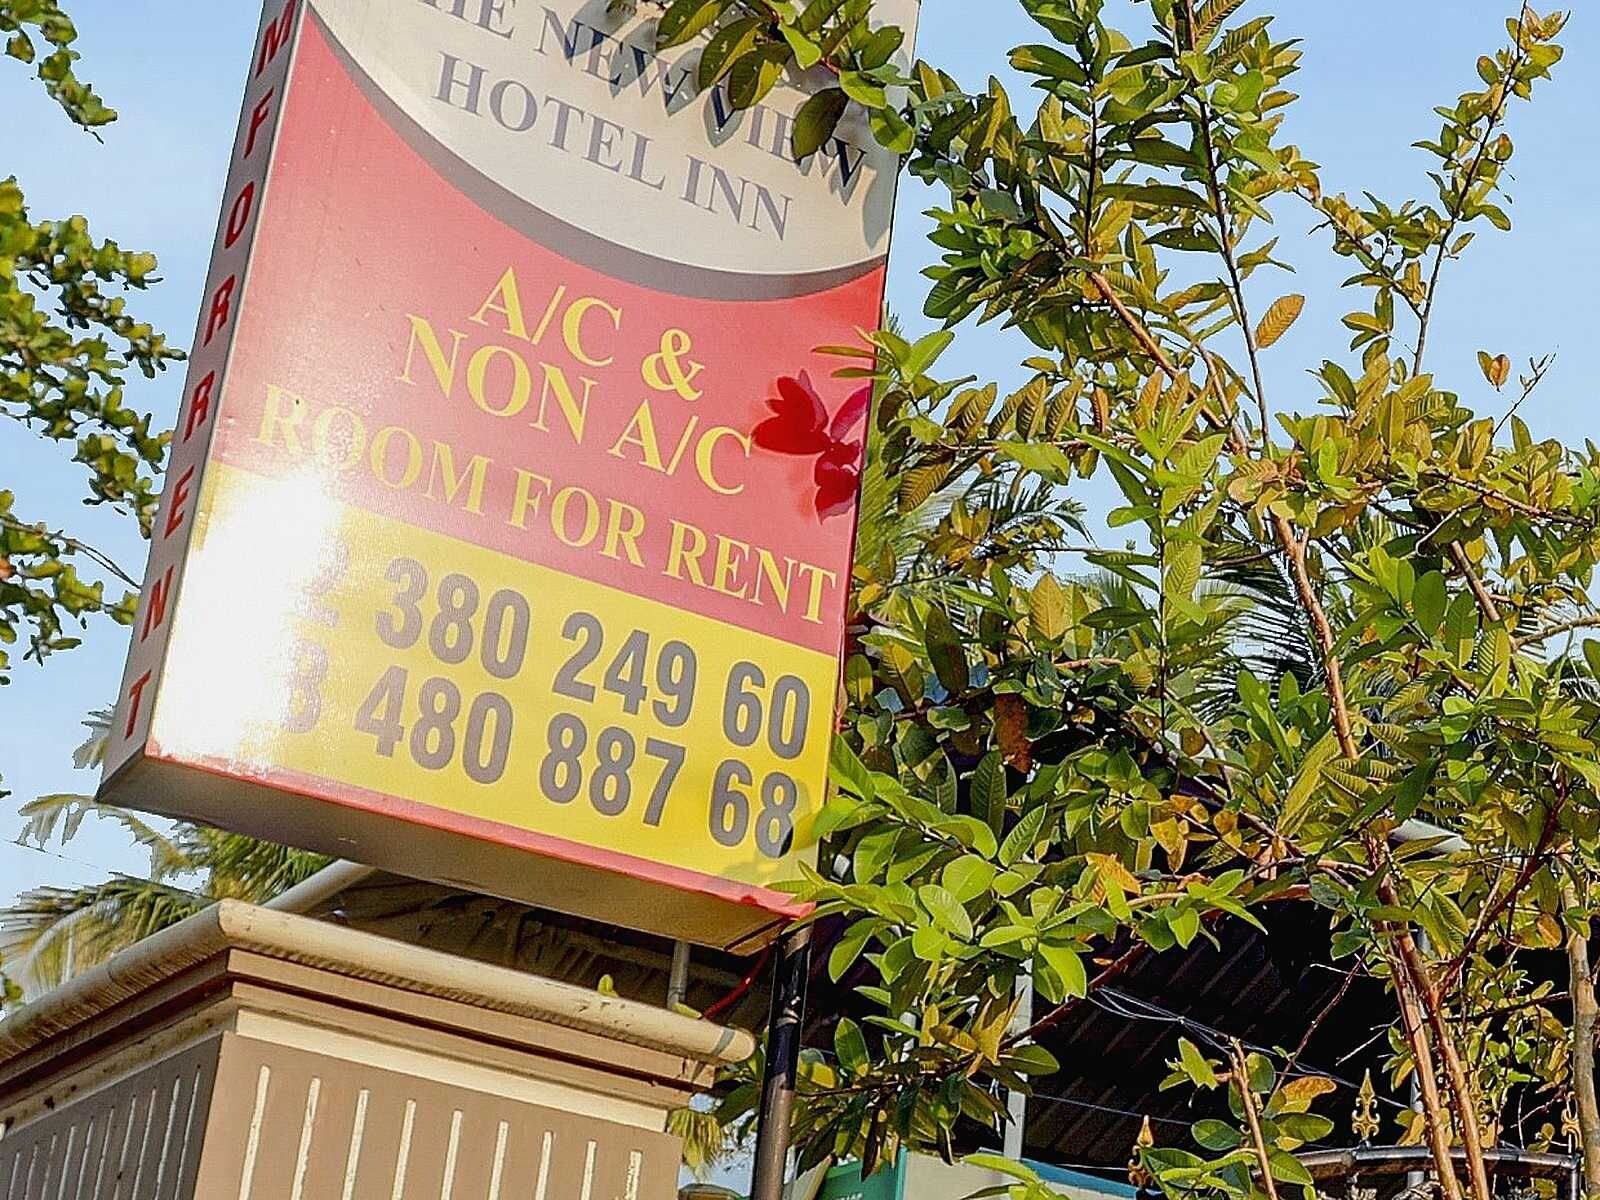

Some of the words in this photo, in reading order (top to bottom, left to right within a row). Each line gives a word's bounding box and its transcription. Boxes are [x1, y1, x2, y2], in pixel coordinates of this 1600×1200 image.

[431, 51, 666, 191] HOTEL
[679, 154, 793, 241] INN
[533, 6, 693, 108] NEW
[395, 313, 598, 446] NON
[607, 399, 755, 495] A/C
[469, 265, 623, 368] A/C
[641, 328, 705, 401] &
[255, 383, 495, 517] ROOM
[506, 467, 646, 568] FOR
[662, 518, 838, 626] RENT
[375, 557, 531, 680] 380
[552, 612, 697, 727] 249
[722, 662, 811, 760] 60
[354, 664, 513, 785] 480
[539, 712, 686, 828] 887
[709, 759, 798, 859] 68
